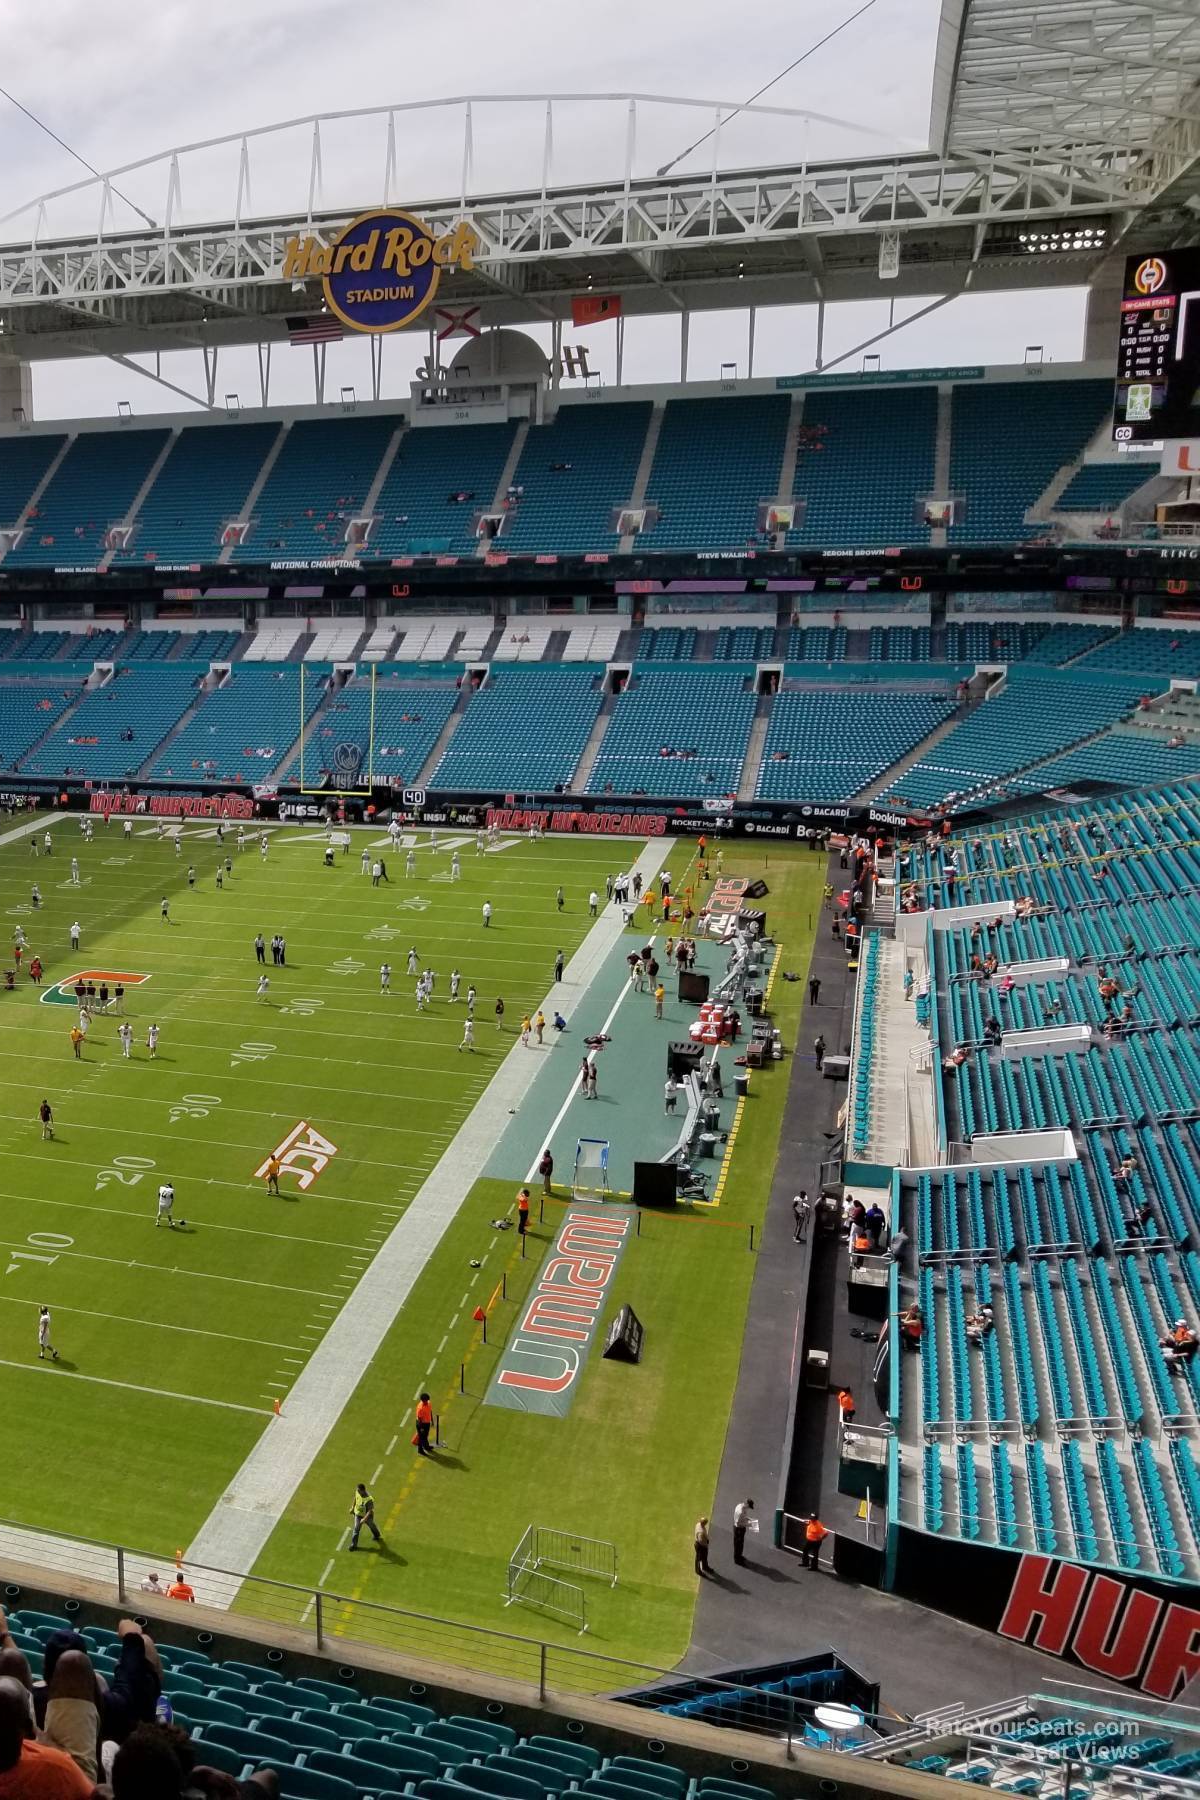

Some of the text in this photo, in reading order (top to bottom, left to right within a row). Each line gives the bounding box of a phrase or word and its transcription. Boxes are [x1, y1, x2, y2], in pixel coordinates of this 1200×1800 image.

[283, 222, 477, 279] Hard Rock
[346, 285, 414, 303] STADIUM
[1121, 334, 1169, 345] 0:00 0:00
[1117, 430, 1131, 438] CC
[1160, 550, 1198, 558] RING
[271, 560, 360, 569] NATIONAL CHAMPIONS
[406, 791, 422, 803] 40
[486, 809, 550, 828] MIAMI
[813, 807, 850, 817] BACARDÍ
[671, 819, 701, 827] ROCKET
[756, 825, 790, 834] BACARDÍ
[363, 928, 400, 941] 30
[325, 961, 365, 975] 40
[279, 998, 325, 1016] 50
[230, 1042, 277, 1061] 40
[168, 1094, 223, 1118] 30
[254, 1121, 338, 1190] ACC
[96, 1156, 156, 1186] 20
[10, 1231, 75, 1266] 10
